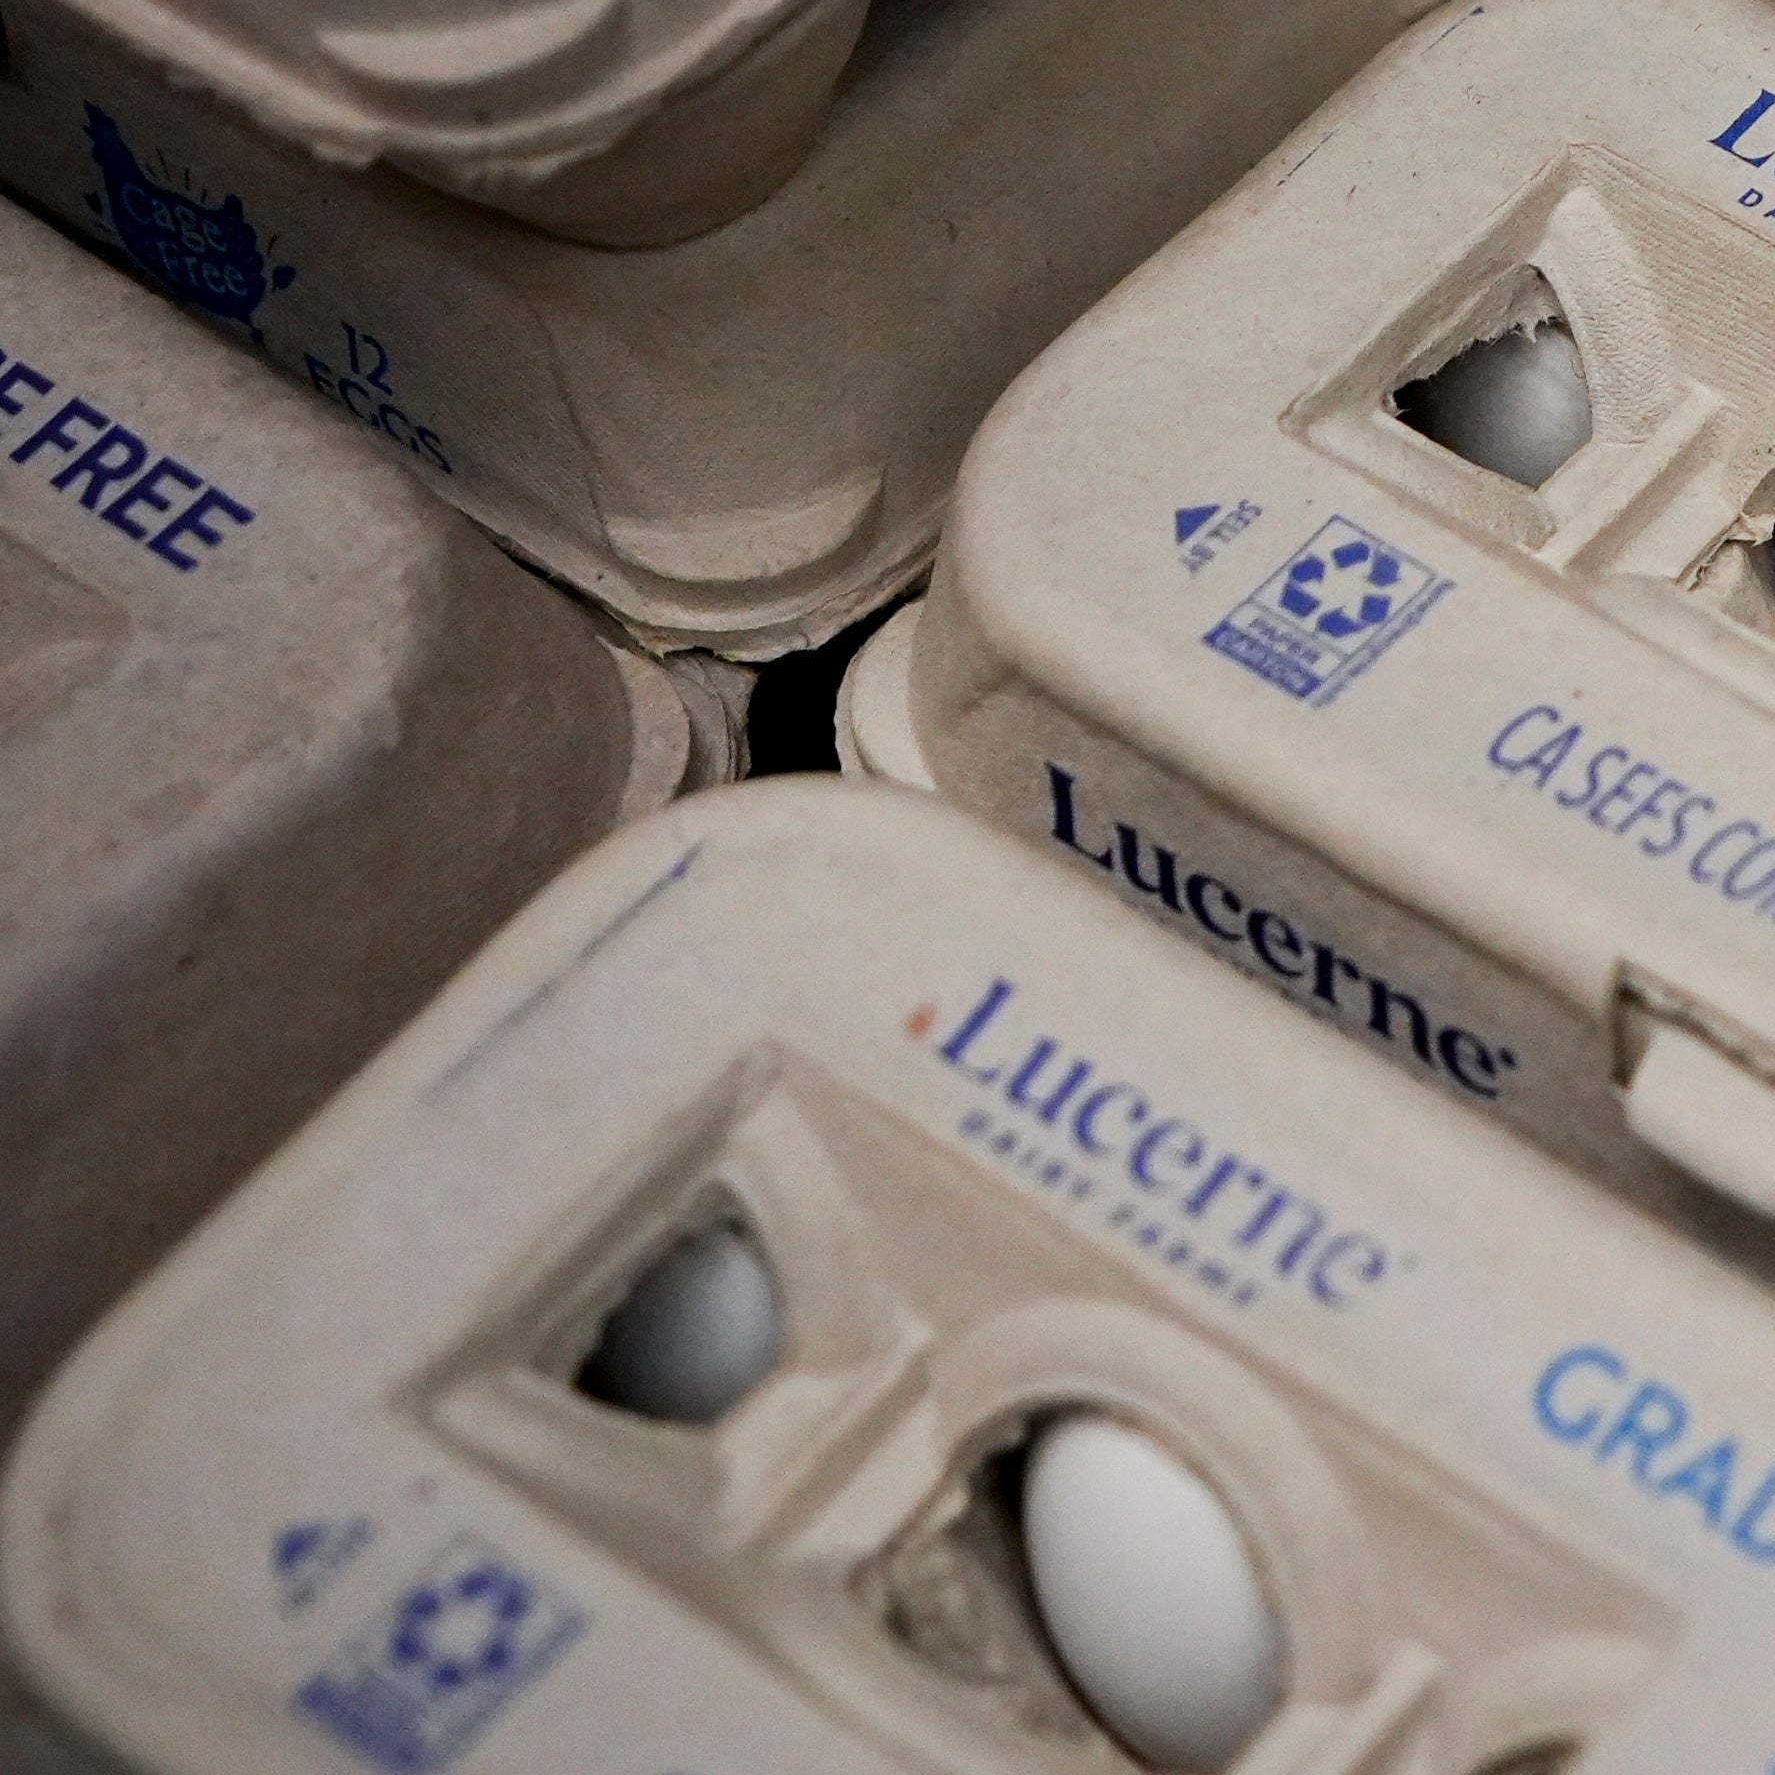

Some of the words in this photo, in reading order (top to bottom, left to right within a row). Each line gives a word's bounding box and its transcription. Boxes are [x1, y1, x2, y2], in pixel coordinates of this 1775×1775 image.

[121, 182, 229, 254] Cage
[156, 239, 250, 298] Free
[304, 351, 453, 477] EGGS
[340, 319, 394, 397] 12
[8, 396, 257, 573] FREE
[1486, 701, 1569, 785] CA
[1559, 744, 1718, 861] SEFS
[1041, 760, 1503, 1102] Lucerne
[930, 974, 1392, 1312] Lucerne
